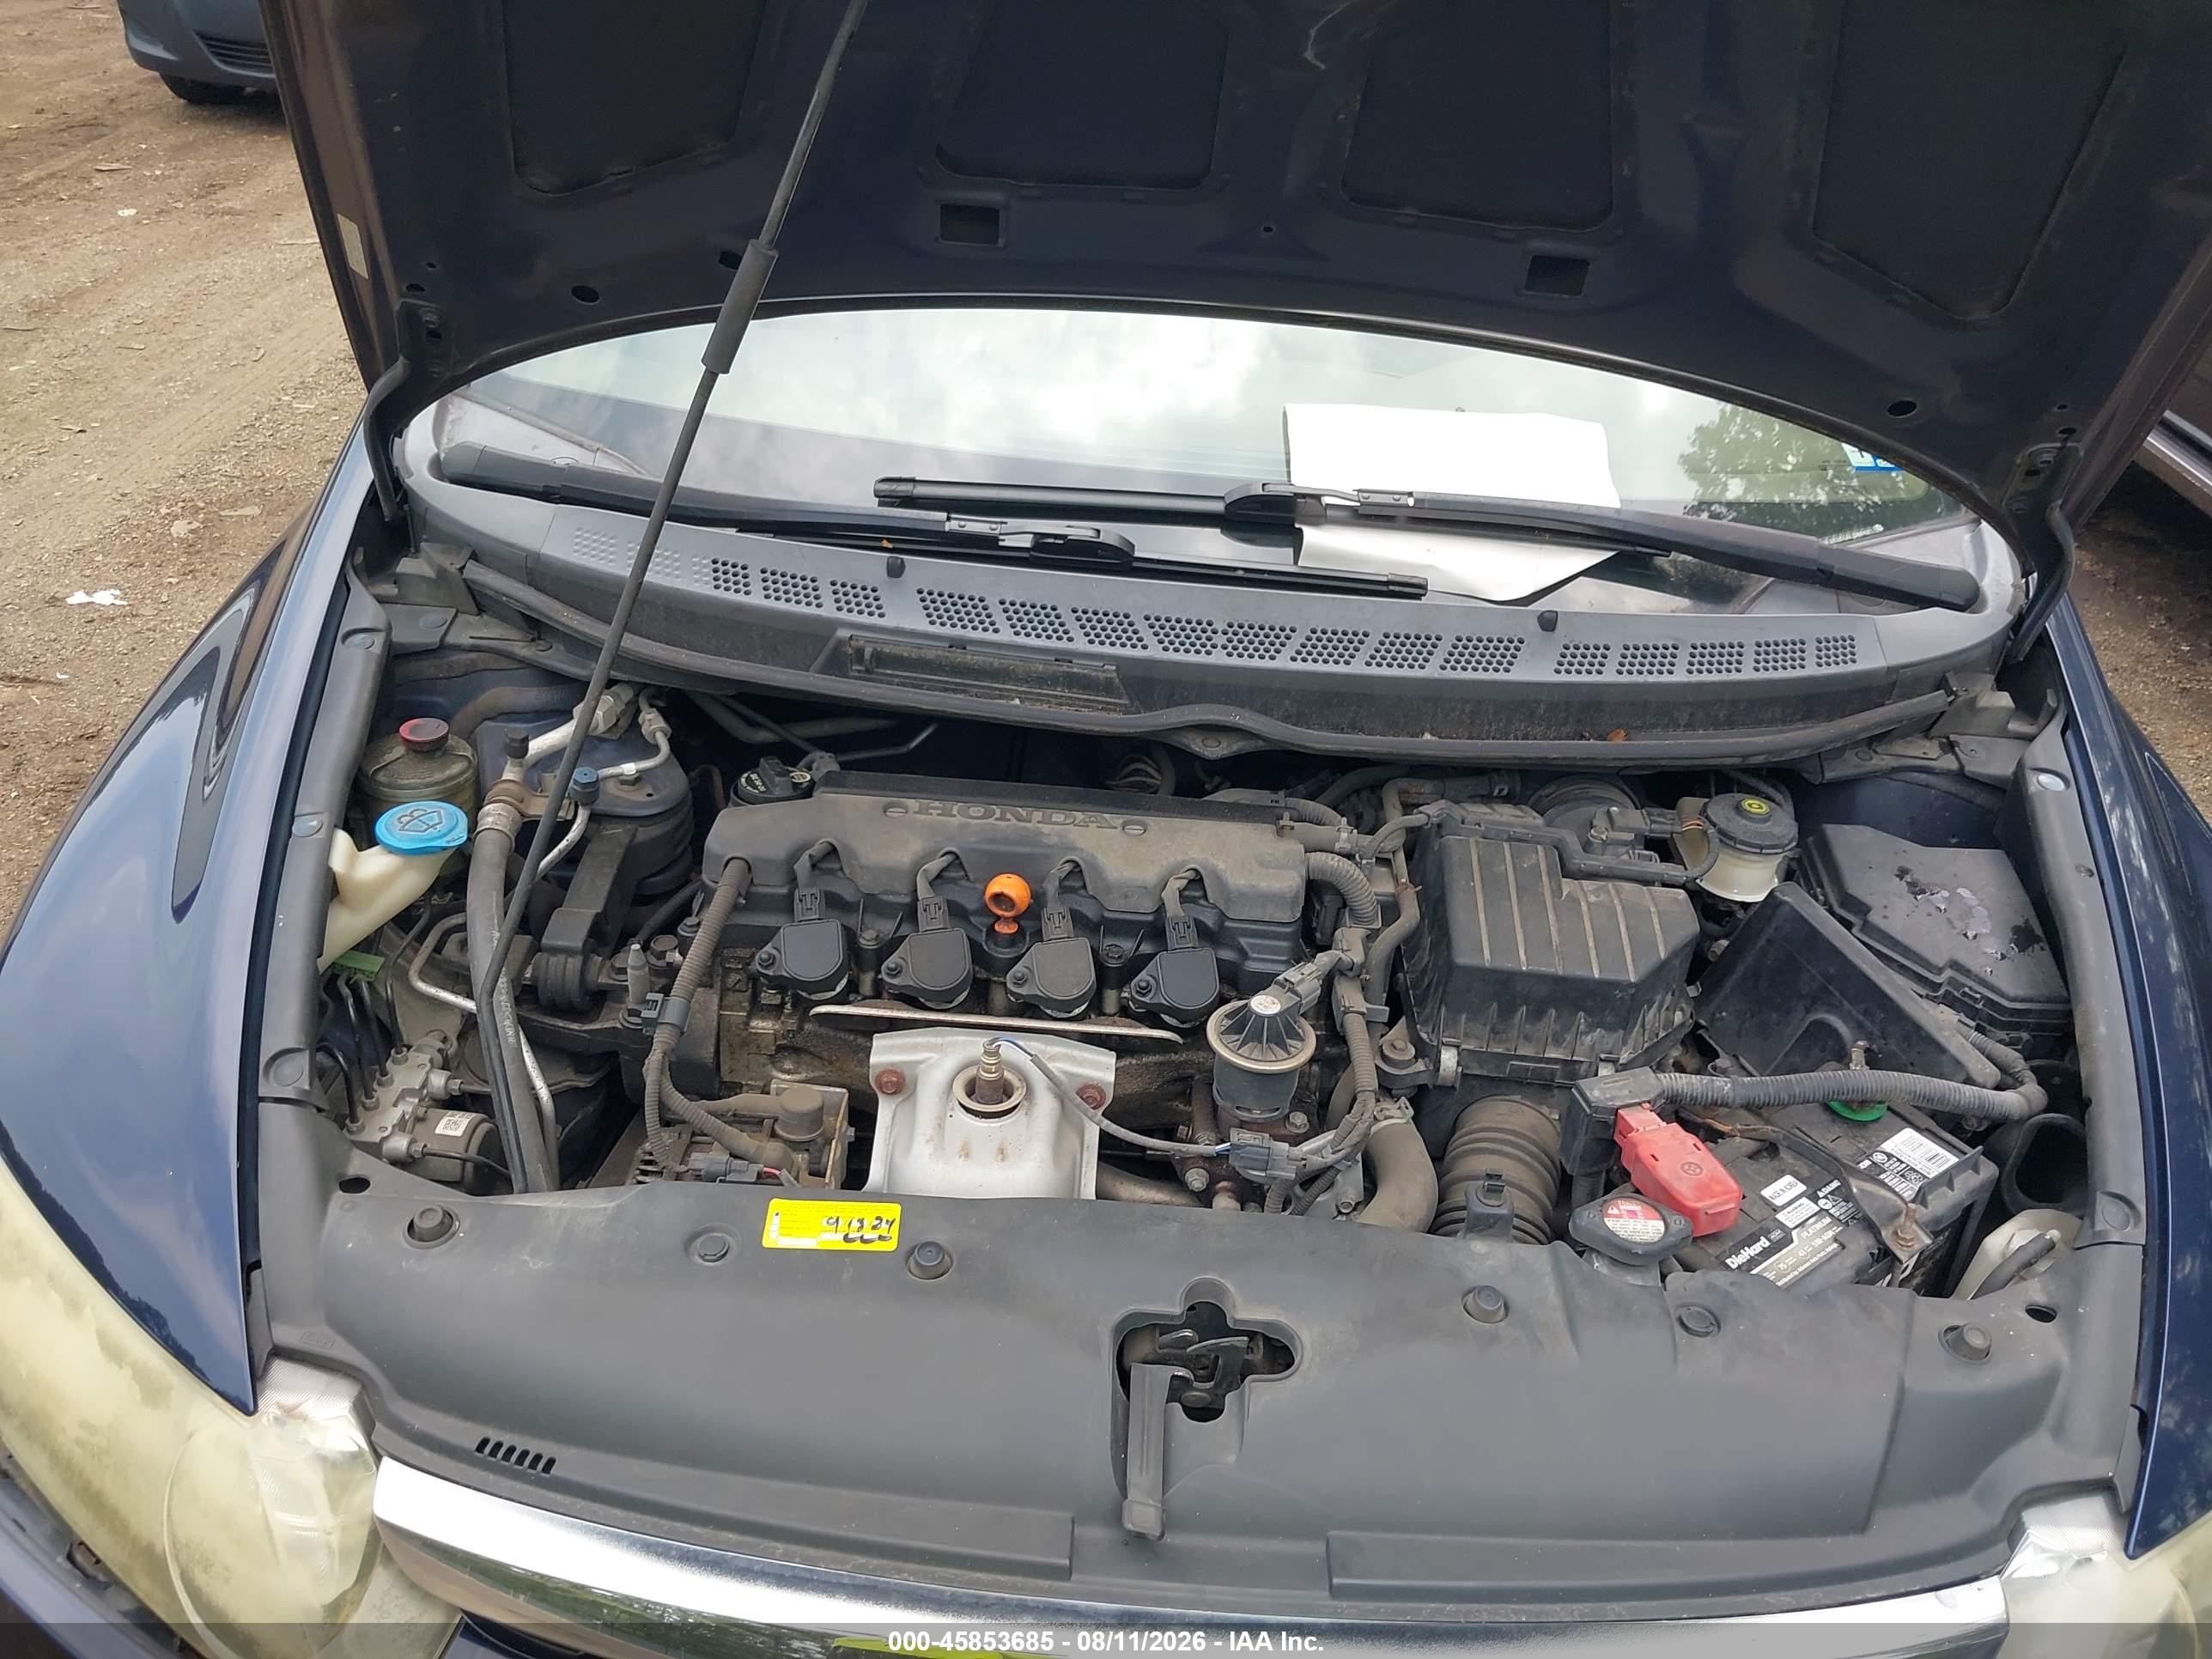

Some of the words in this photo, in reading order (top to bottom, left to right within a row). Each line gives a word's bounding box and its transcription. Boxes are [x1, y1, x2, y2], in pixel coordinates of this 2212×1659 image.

[913, 799, 1118, 830] HONDA
[1800, 1216, 1832, 1239] PLATINUM
[1724, 1236, 1771, 1269] DieHard
